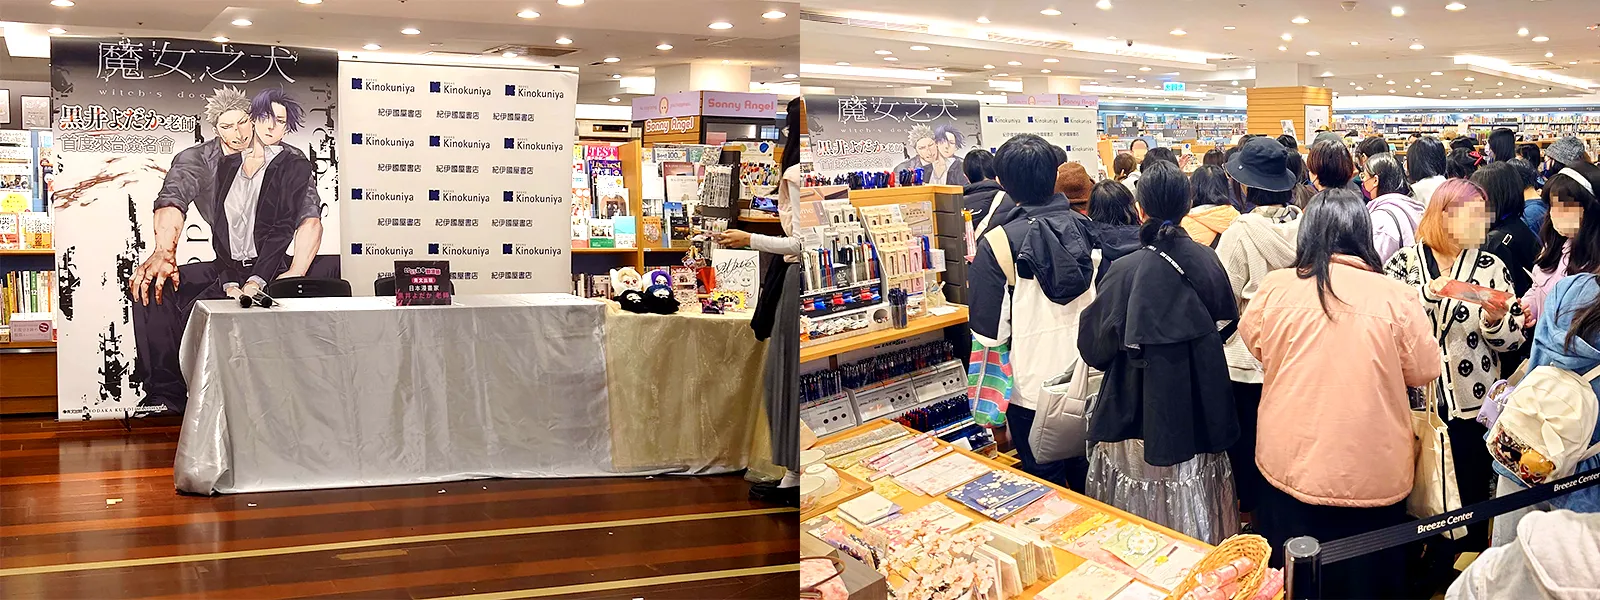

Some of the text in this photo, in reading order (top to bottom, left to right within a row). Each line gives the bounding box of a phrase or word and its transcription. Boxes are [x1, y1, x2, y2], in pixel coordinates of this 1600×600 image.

[97, 37, 298, 83] 魔女之犬
[366, 82, 415, 94] Kinokuniya
[443, 85, 491, 97] Kinokuniya
[518, 88, 564, 100] Kinokuniya
[708, 98, 774, 112] Sonny Angel
[838, 95, 958, 124] 魔女之犬
[645, 116, 694, 133] Sonny Angel
[61, 133, 175, 154] 首度來台簽名會
[366, 137, 414, 148] Kinokuniya
[443, 139, 490, 151] Kinokuniya
[517, 142, 563, 152] Kinokuniya
[366, 192, 414, 203] Kinokuniya
[443, 194, 490, 204] Kinokuniya
[516, 195, 562, 205] Kinokuniya
[366, 246, 413, 257] Kinokuniya
[442, 247, 489, 257] Kinokuniya
[515, 248, 561, 257] Kinokuniya
[1554, 472, 1600, 492] Breeze Center
[1417, 511, 1474, 534] Breeze Center
